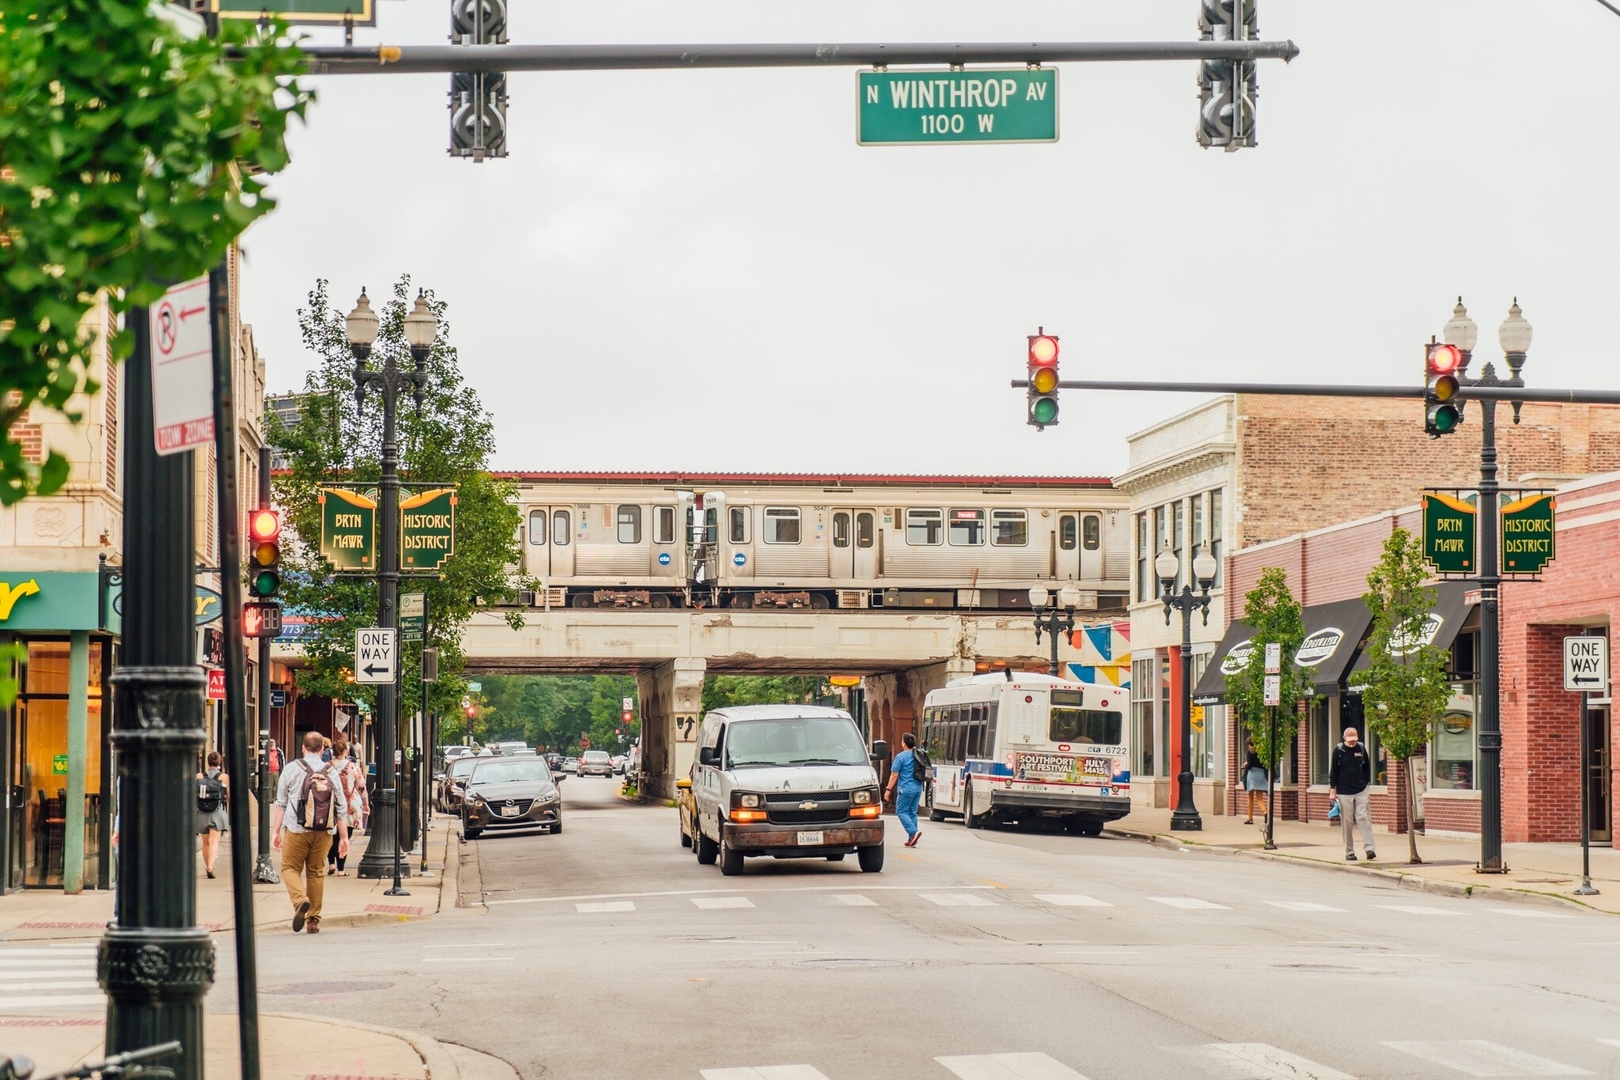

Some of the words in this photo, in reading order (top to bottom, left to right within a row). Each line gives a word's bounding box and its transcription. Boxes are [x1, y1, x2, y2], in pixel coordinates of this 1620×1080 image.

[867, 84, 879, 104] N
[889, 78, 1017, 109] WINTHROP
[1025, 81, 1047, 101] AV
[920, 113, 965, 134] 1100
[977, 113, 994, 133] W
[158, 426, 182, 449] TOW
[185, 419, 214, 444] ZONE
[335, 514, 362, 528] BRYN
[403, 514, 451, 529] HISTORIC
[1437, 518, 1463, 532] BRYN
[1505, 518, 1552, 533] HISTORIC
[332, 534, 364, 549] MAWR
[405, 535, 450, 549] DISTRICT
[1434, 538, 1465, 552] MAWR
[1506, 539, 1551, 553] DISTRICT
[282, 624, 305, 634] 773)
[362, 633, 390, 646] ONE
[1300, 636, 1339, 649] EDGEWATER
[361, 648, 390, 660] WAY
[1571, 642, 1600, 657] ONE
[1570, 658, 1600, 673] WAY
[210, 676, 225, 685] AT
[1105, 747, 1127, 755] 6722
[1020, 755, 1073, 766] SOUTHPORT
[1084, 759, 1105, 768] JULY
[1019, 763, 1037, 771] ART
[1037, 764, 1073, 774] FESTIVAL
